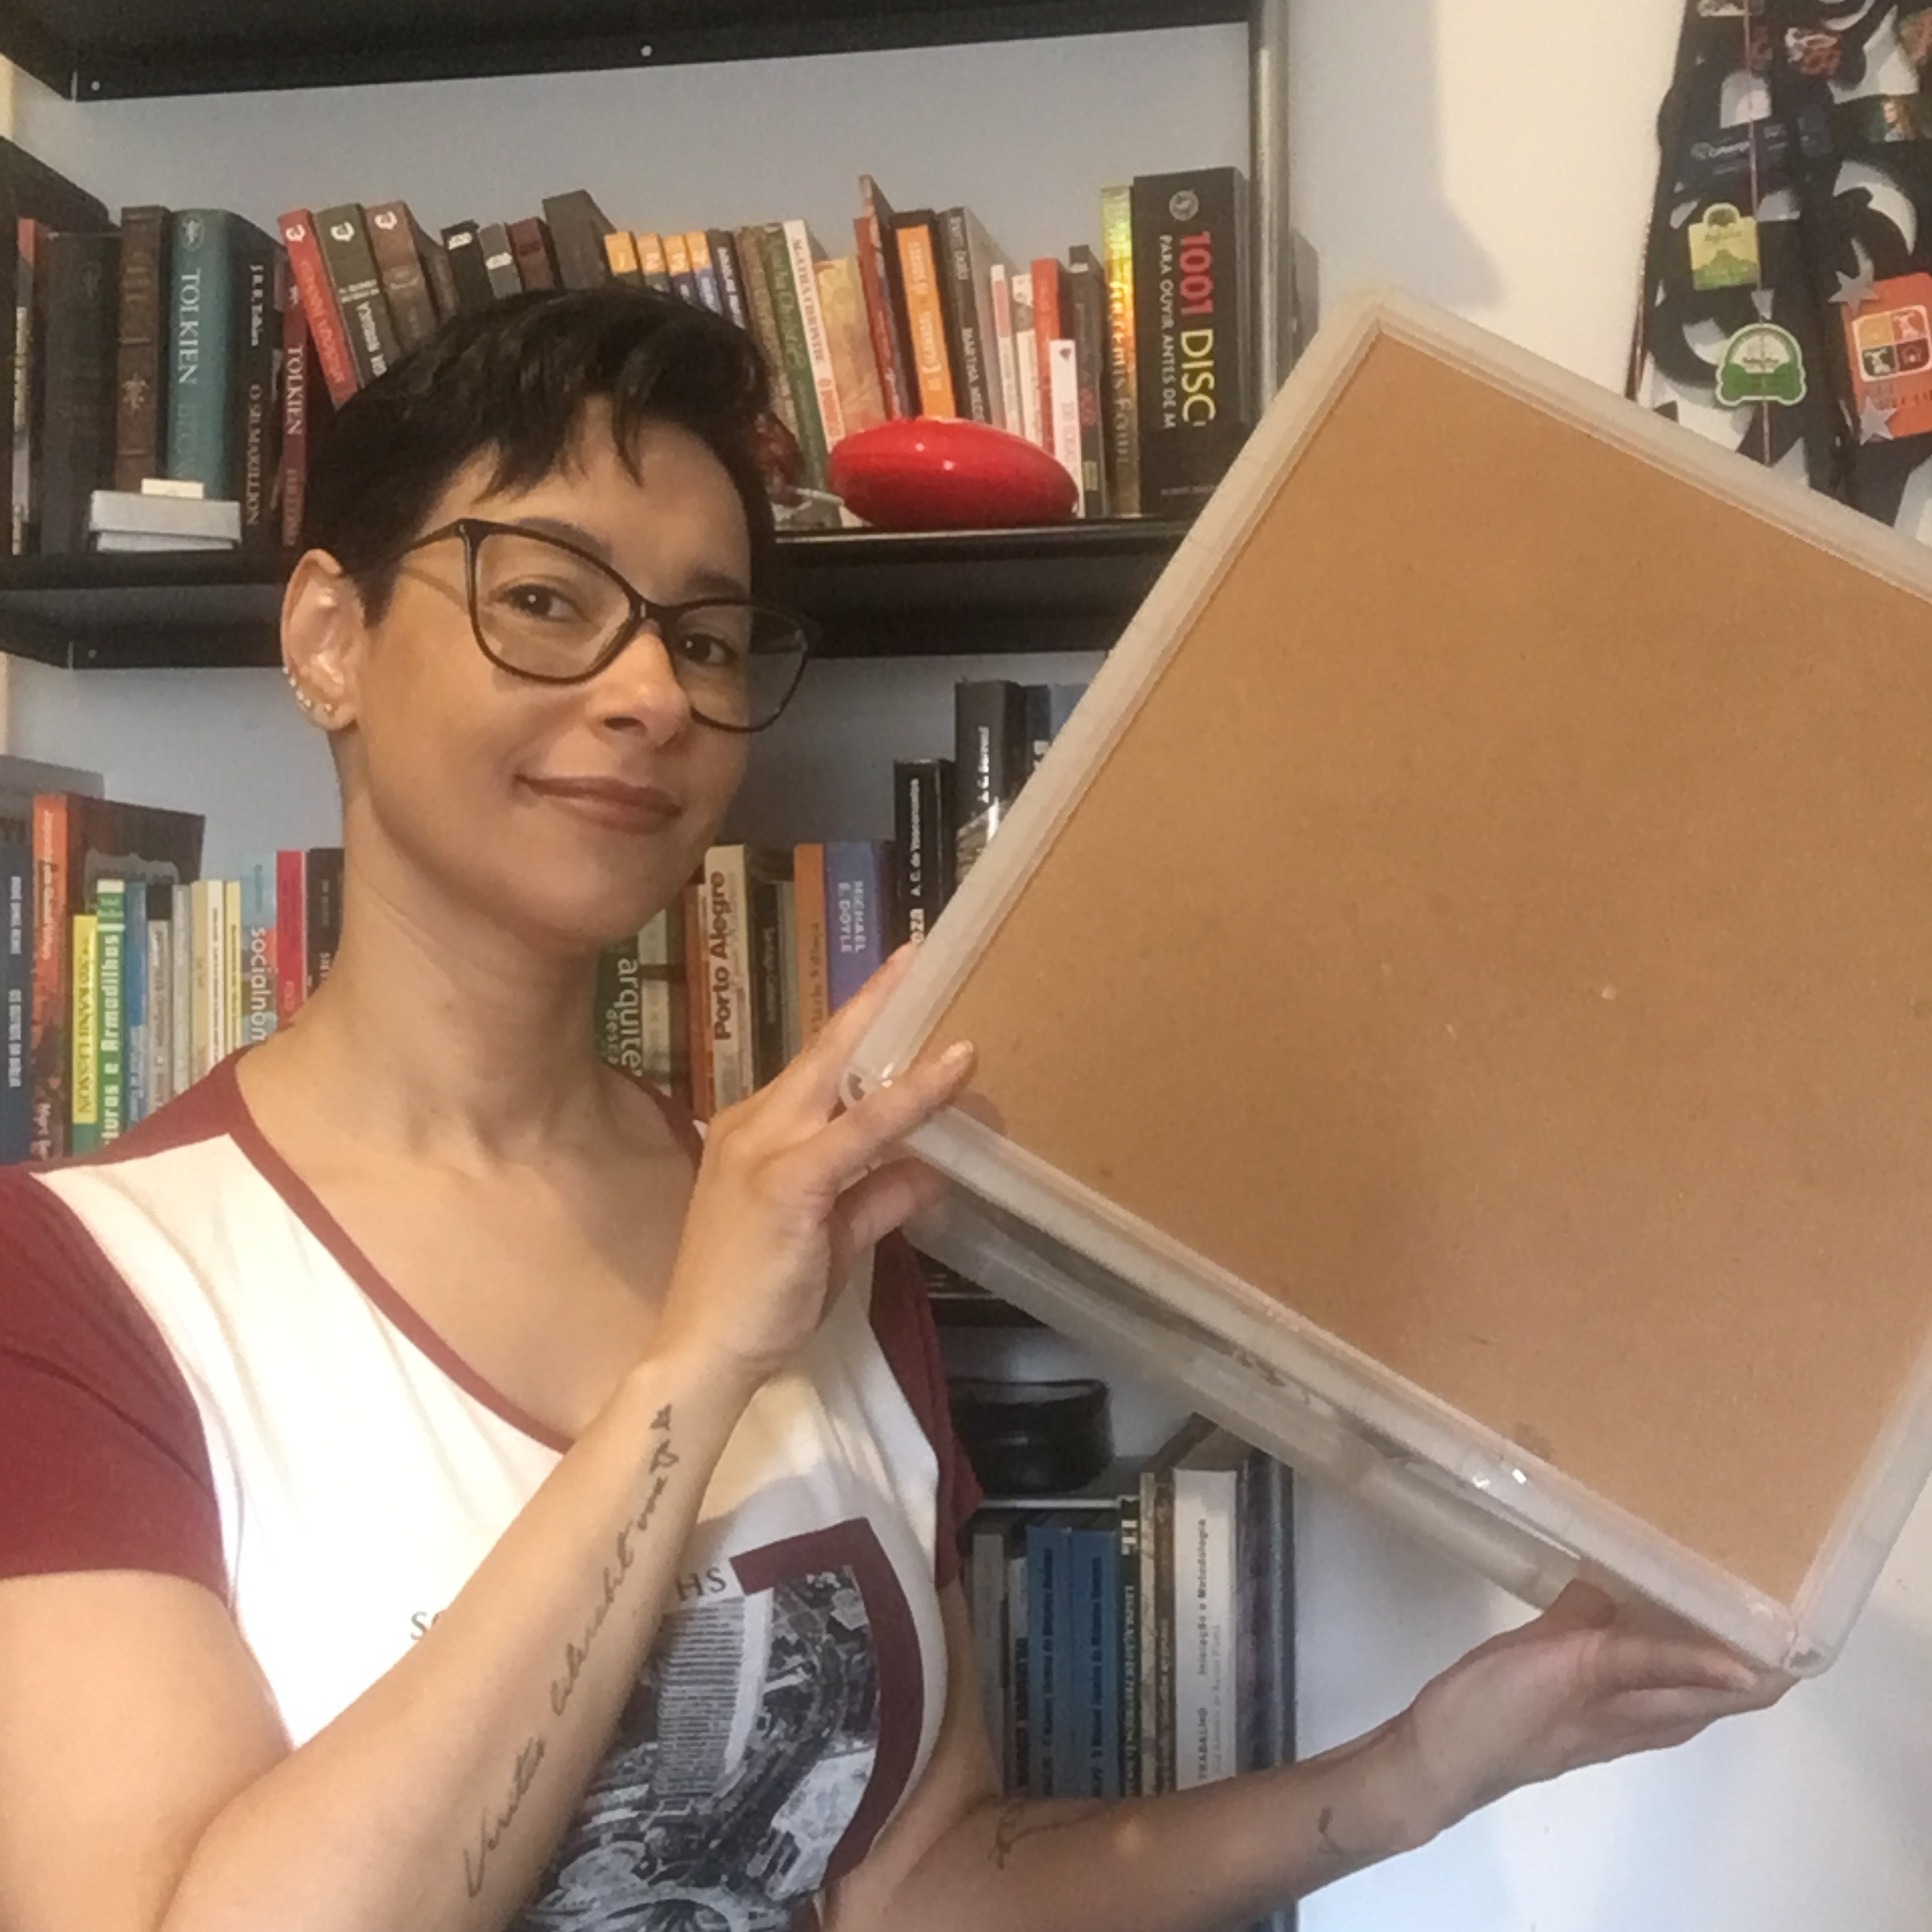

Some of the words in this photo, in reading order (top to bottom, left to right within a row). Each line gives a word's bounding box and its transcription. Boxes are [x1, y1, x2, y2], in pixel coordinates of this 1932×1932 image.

[1159, 235, 1172, 276] PARA
[1179, 231, 1213, 316] 1001
[178, 269, 200, 385] TOLKIEN
[1159, 279, 1175, 330] OUVIR
[1160, 335, 1176, 385] ANTES
[286, 346, 304, 436] TOLKIEN
[1161, 388, 1176, 406] DE
[710, 870, 732, 960] Alegre
[839, 901, 852, 954] DOYLE
[853, 881, 867, 953] MICHAEL
[713, 970, 732, 1041] Porto
[105, 1061, 120, 1075] e
[102, 1085, 120, 1144] turas
